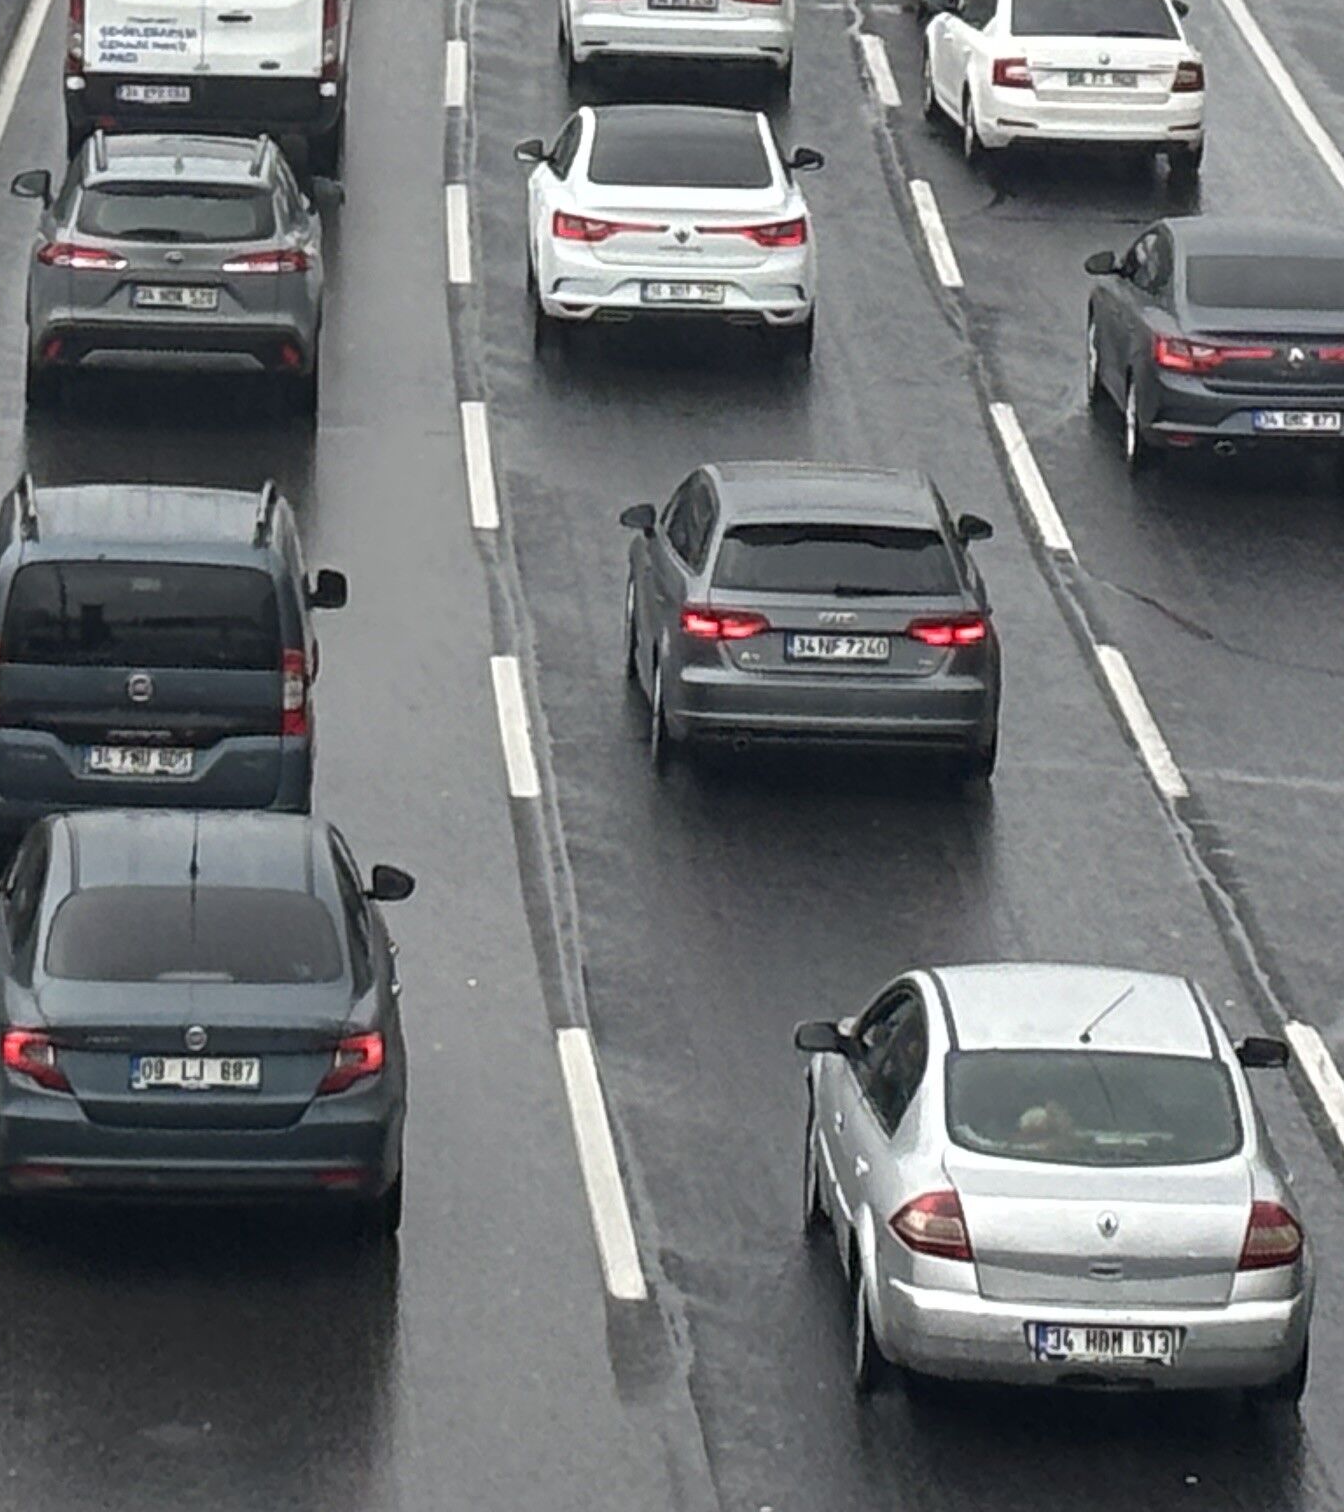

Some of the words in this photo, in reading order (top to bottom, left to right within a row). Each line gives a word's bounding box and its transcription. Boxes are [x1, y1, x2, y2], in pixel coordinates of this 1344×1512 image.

[141, 1059, 166, 1080] 09
[181, 1060, 205, 1081] LJ
[1048, 1328, 1074, 1352] 34
